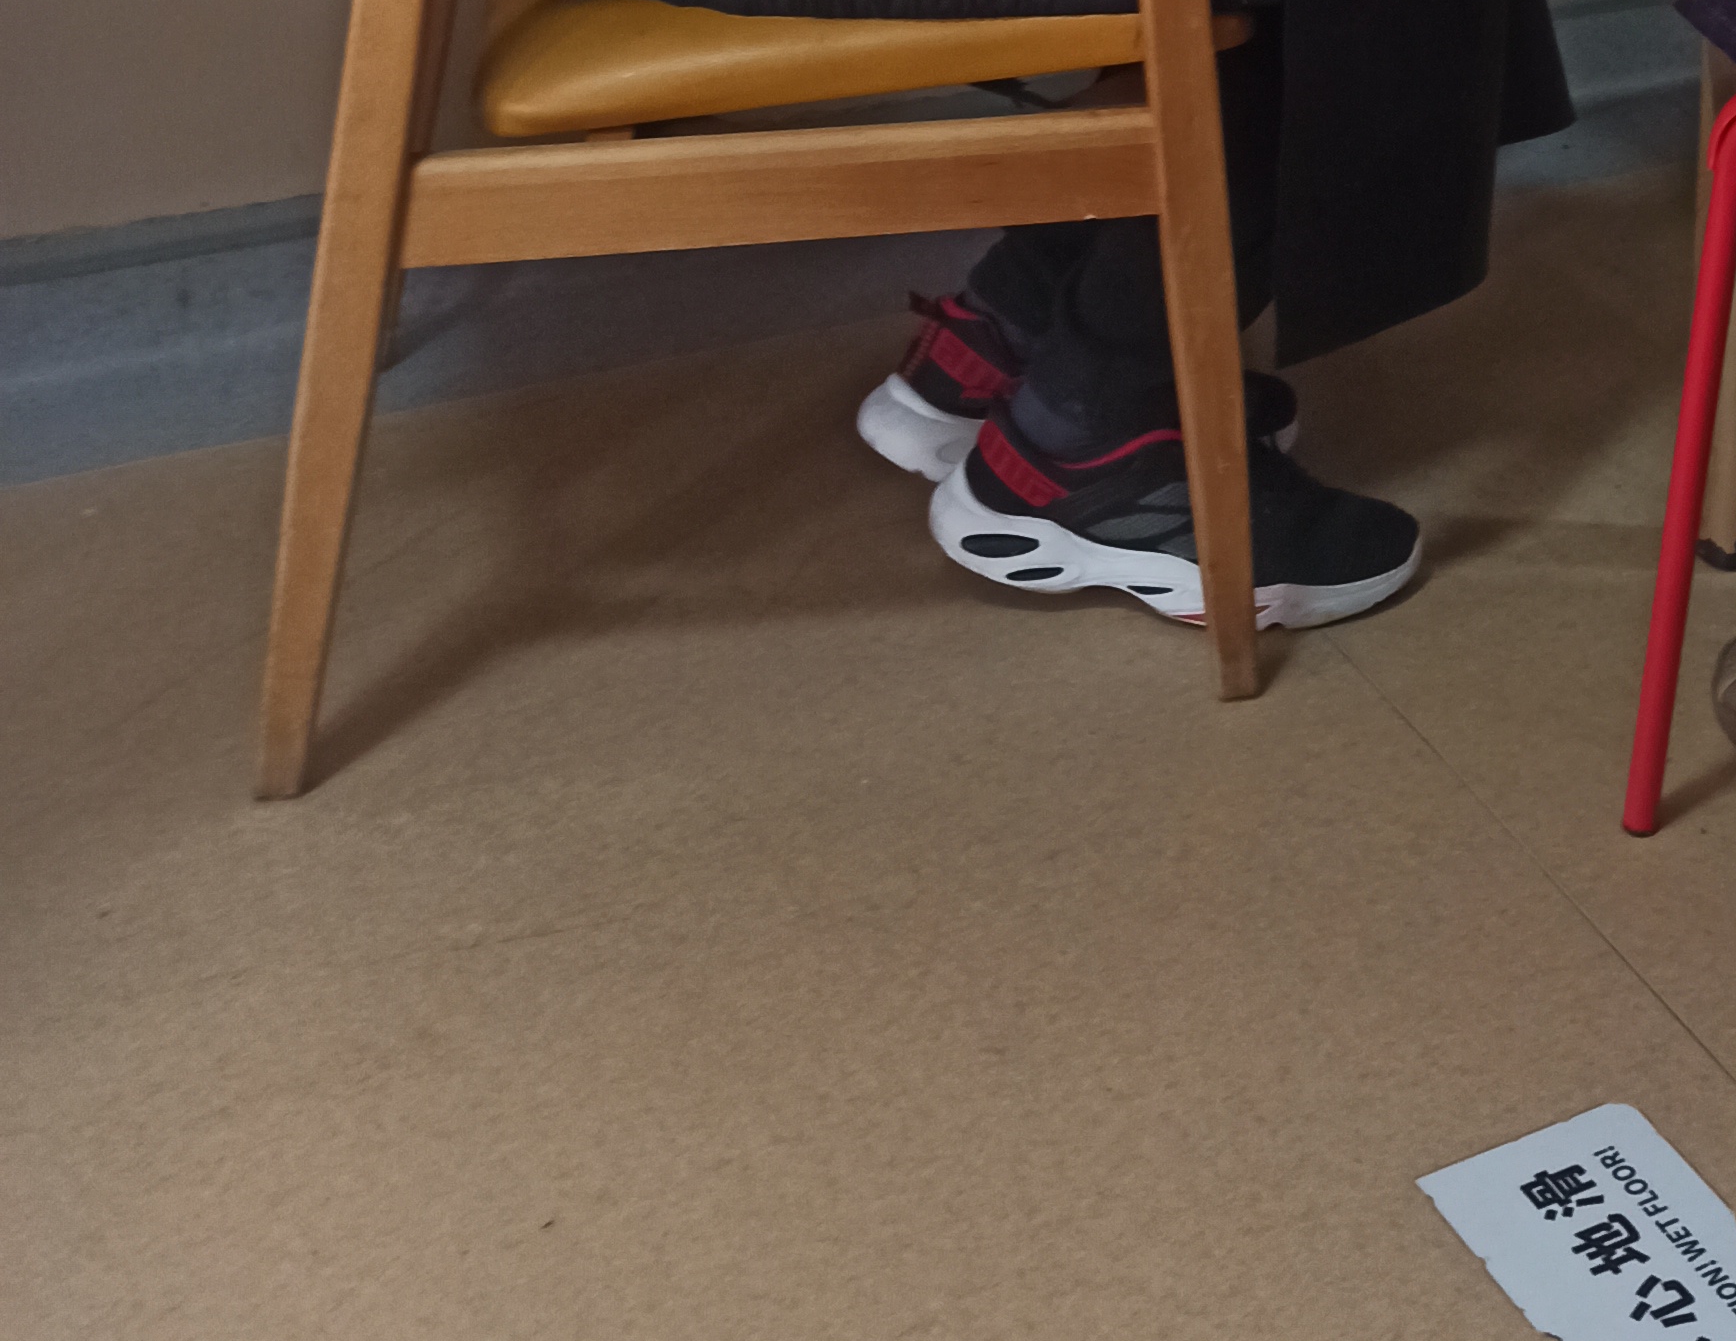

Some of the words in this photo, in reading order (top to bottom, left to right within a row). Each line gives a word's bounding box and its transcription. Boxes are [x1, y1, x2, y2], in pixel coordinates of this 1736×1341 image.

[1593, 1145, 1669, 1218] FLOOR!
[1519, 1164, 1711, 1341] 心地滑
[1655, 1217, 1706, 1262] WET
